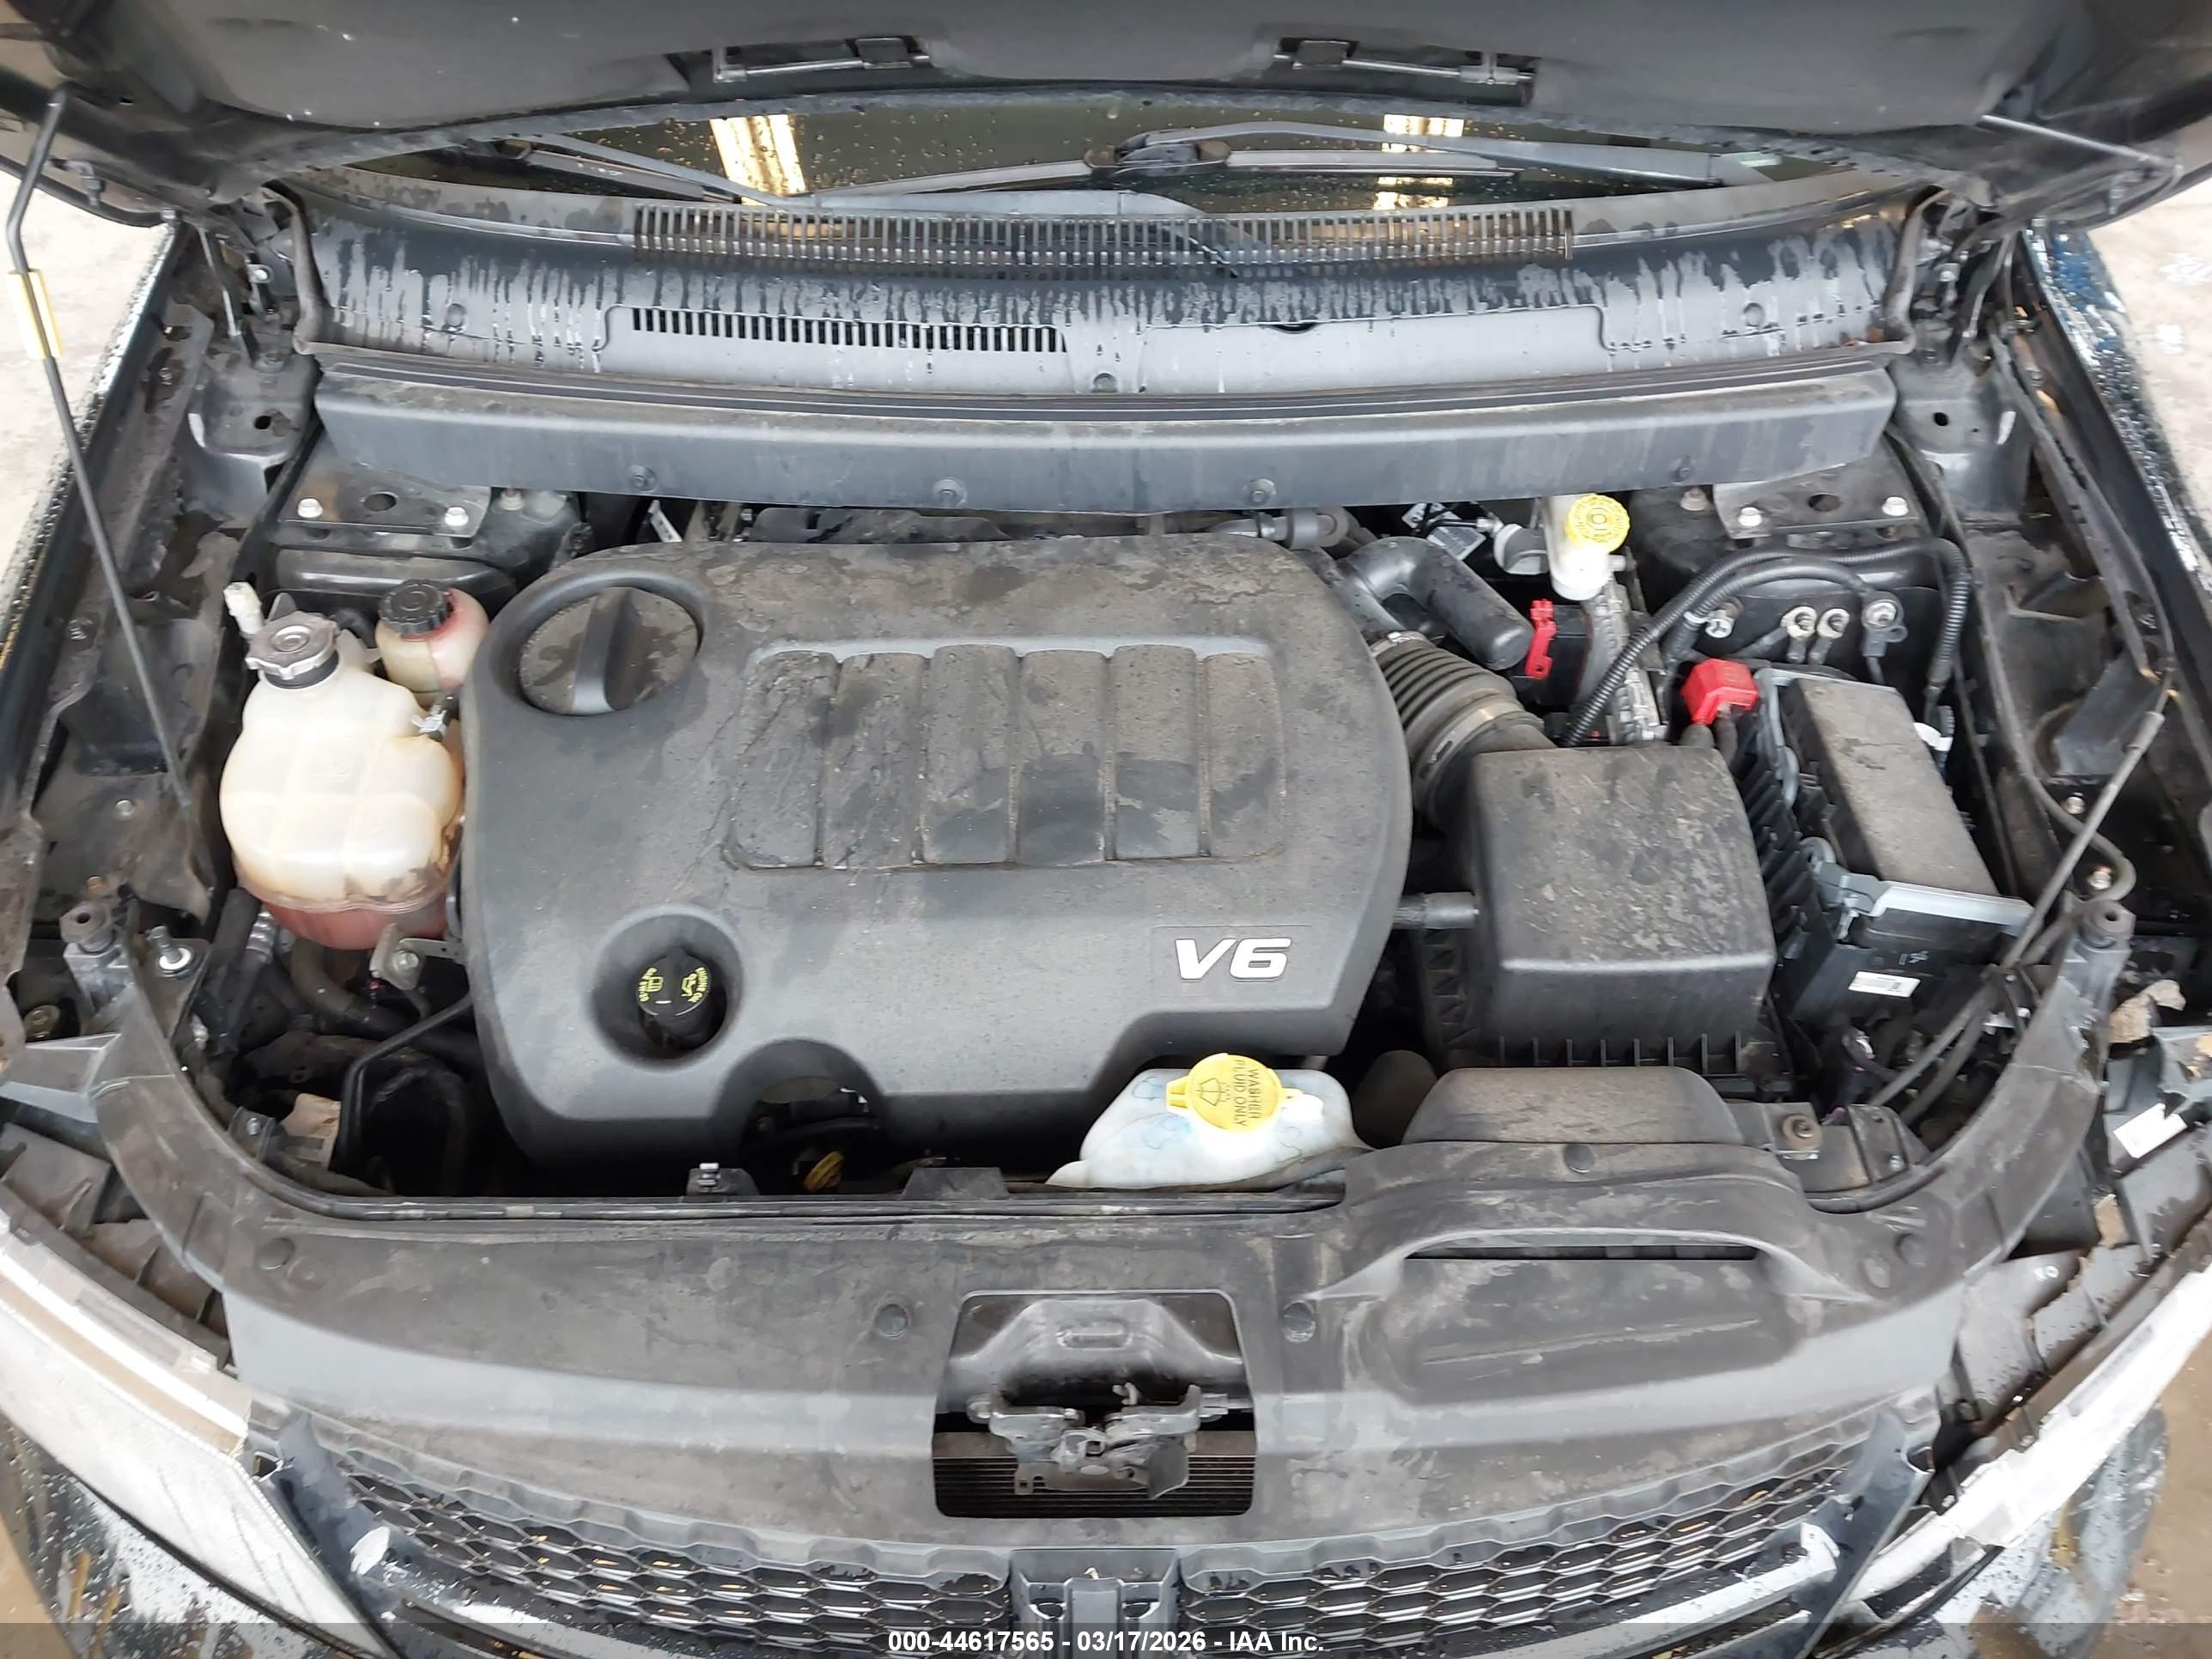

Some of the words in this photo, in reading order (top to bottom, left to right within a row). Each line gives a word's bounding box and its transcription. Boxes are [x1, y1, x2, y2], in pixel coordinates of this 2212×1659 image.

[1175, 938, 1291, 981] V6
[695, 967, 708, 992] ENGINE
[1233, 1059, 1248, 1093] FLUID
[1247, 1068, 1262, 1119] WASHER
[1233, 1096, 1249, 1127] ONLY
